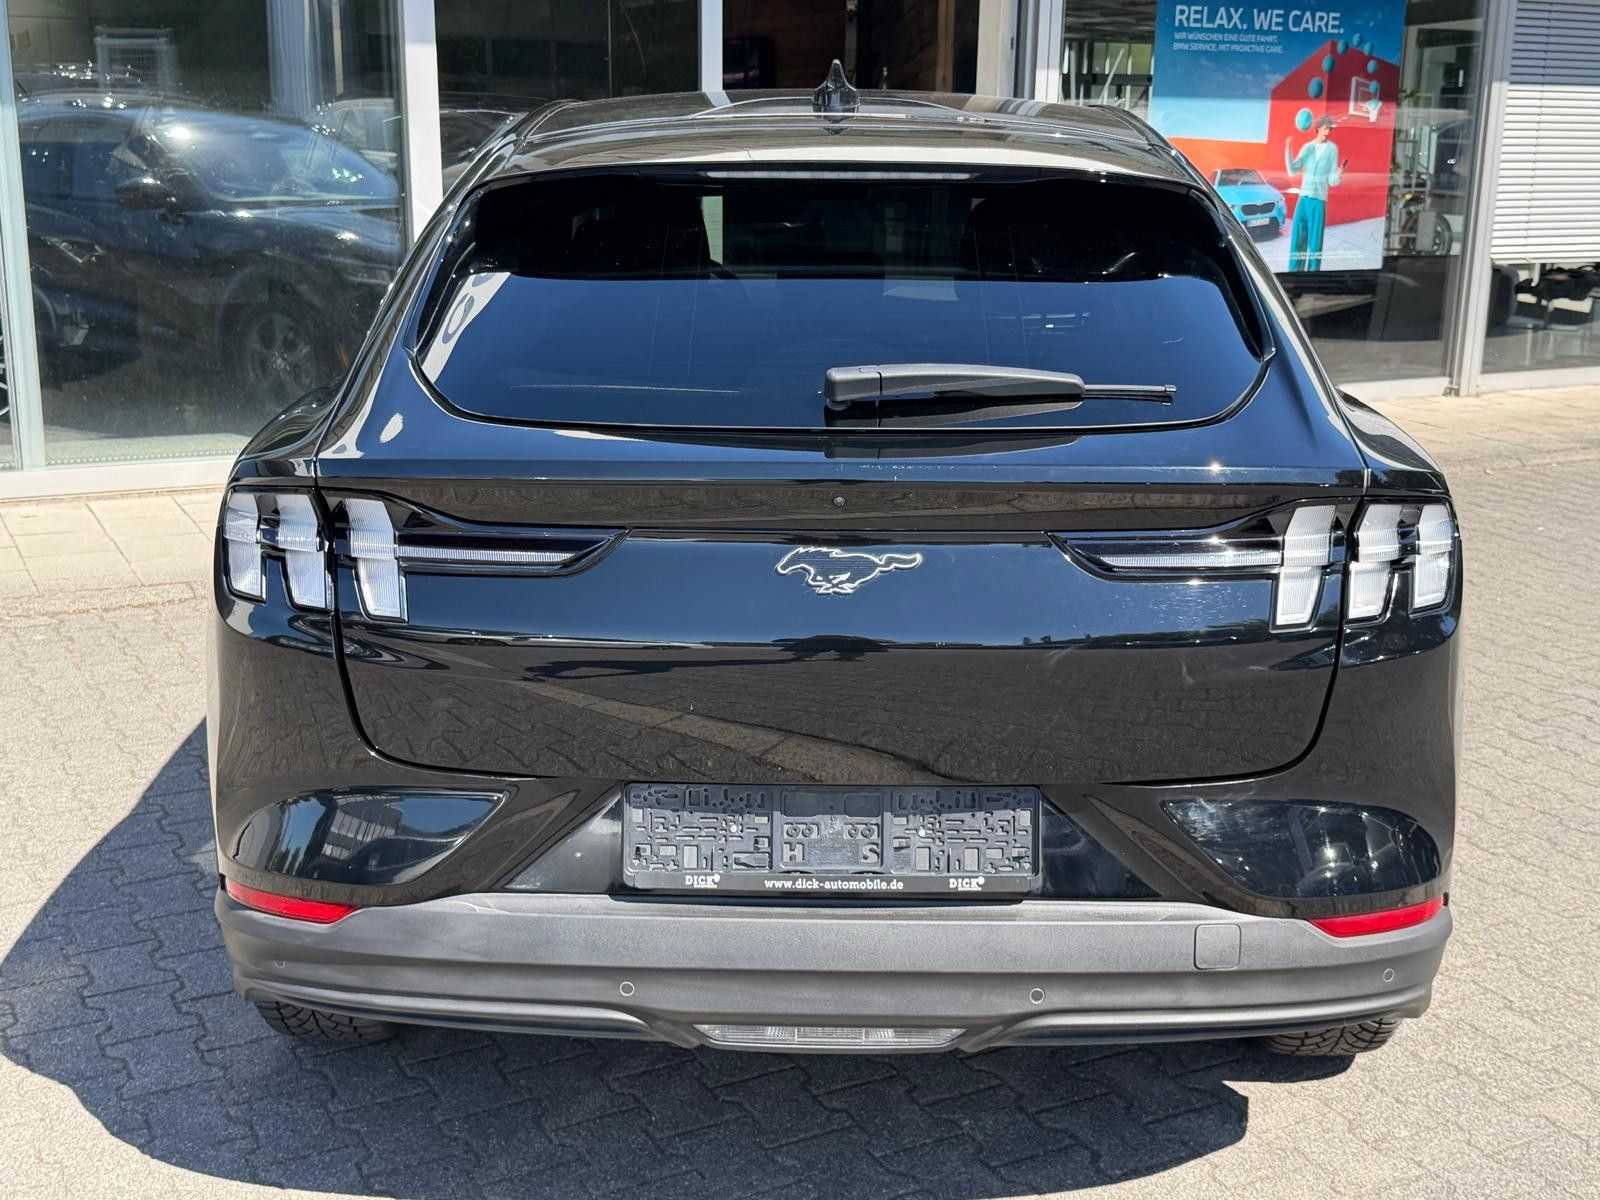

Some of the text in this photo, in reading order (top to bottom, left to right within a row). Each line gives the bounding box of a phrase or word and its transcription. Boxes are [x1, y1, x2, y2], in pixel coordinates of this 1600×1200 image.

[1174, 4, 1345, 34] RELAX. WE CARE.
[1173, 32, 1187, 41] WIR
[1187, 31, 1223, 41] WÜNSCHEN
[1223, 33, 1239, 43] EINE
[1238, 34, 1257, 43] GUTE
[1172, 41, 1190, 51] BMW
[1218, 43, 1230, 52] MIT
[1230, 43, 1265, 53] PROACTIVE
[684, 874, 719, 886] DICK
[764, 878, 904, 890] www.dick-automobile.de
[949, 876, 982, 888] DICK
